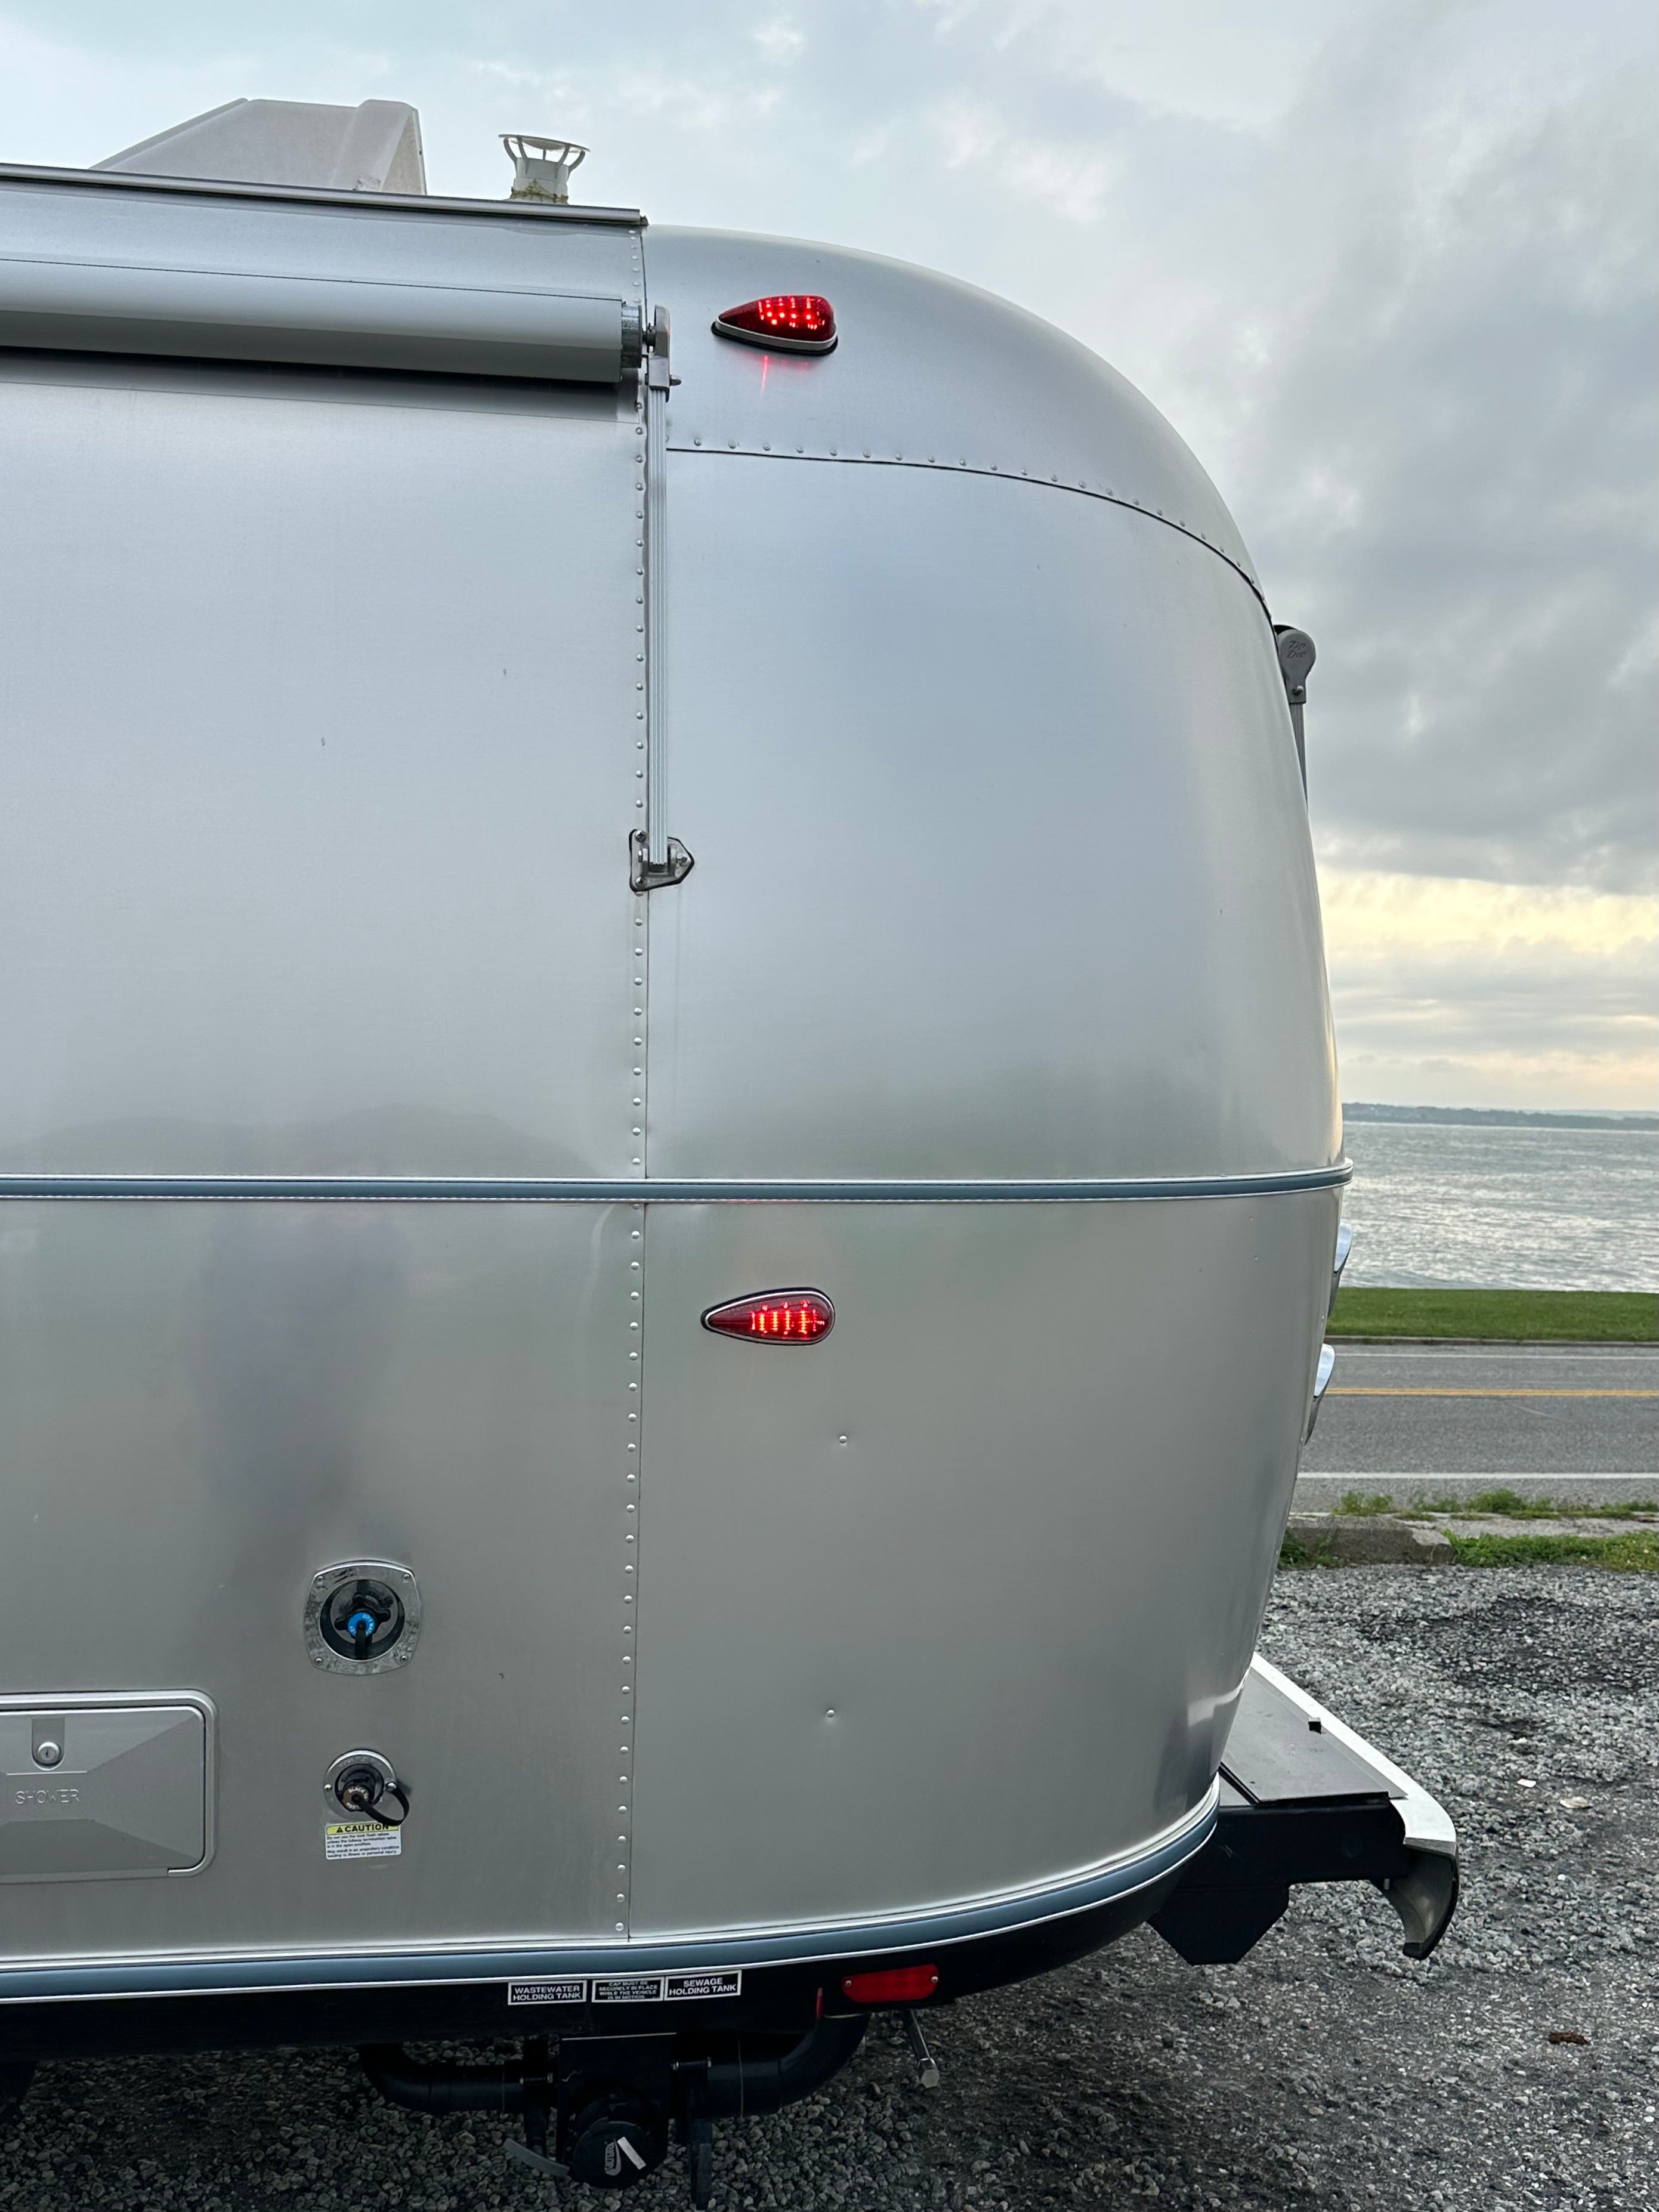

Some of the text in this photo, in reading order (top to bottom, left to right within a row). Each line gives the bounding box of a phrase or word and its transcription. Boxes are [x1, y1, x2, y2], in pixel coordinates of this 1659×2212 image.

[16, 1789, 79, 1803] SHOWER
[684, 1977, 722, 1987] SEWAGE
[515, 1985, 580, 1994] WASTEWATER
[669, 1984, 736, 1995] HOLDING TANK
